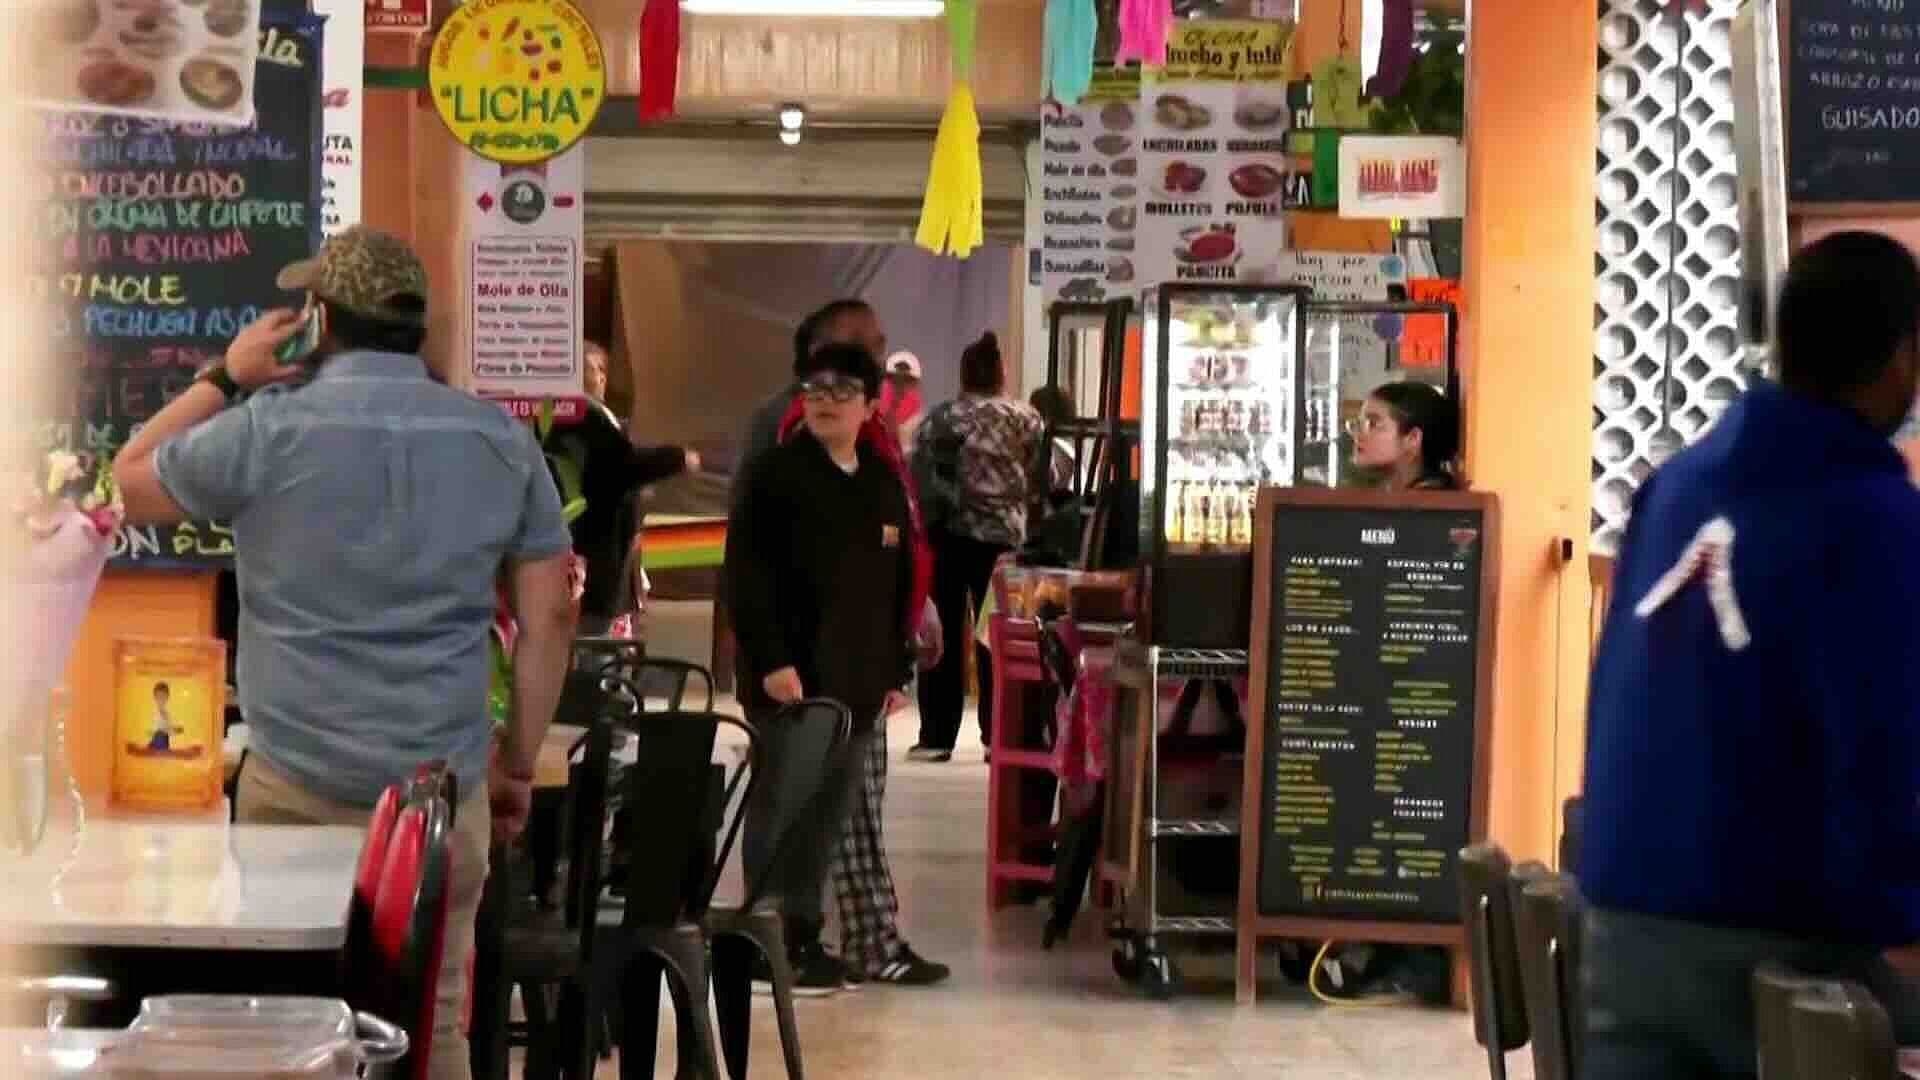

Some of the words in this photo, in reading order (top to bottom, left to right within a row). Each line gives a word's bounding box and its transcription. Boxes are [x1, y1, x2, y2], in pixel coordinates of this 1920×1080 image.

[1145, 203, 1213, 216] MOLLETES
[89, 276, 187, 304] MOLE
[477, 283, 512, 297] Mole
[517, 283, 535, 297] de
[540, 283, 569, 298] Olla
